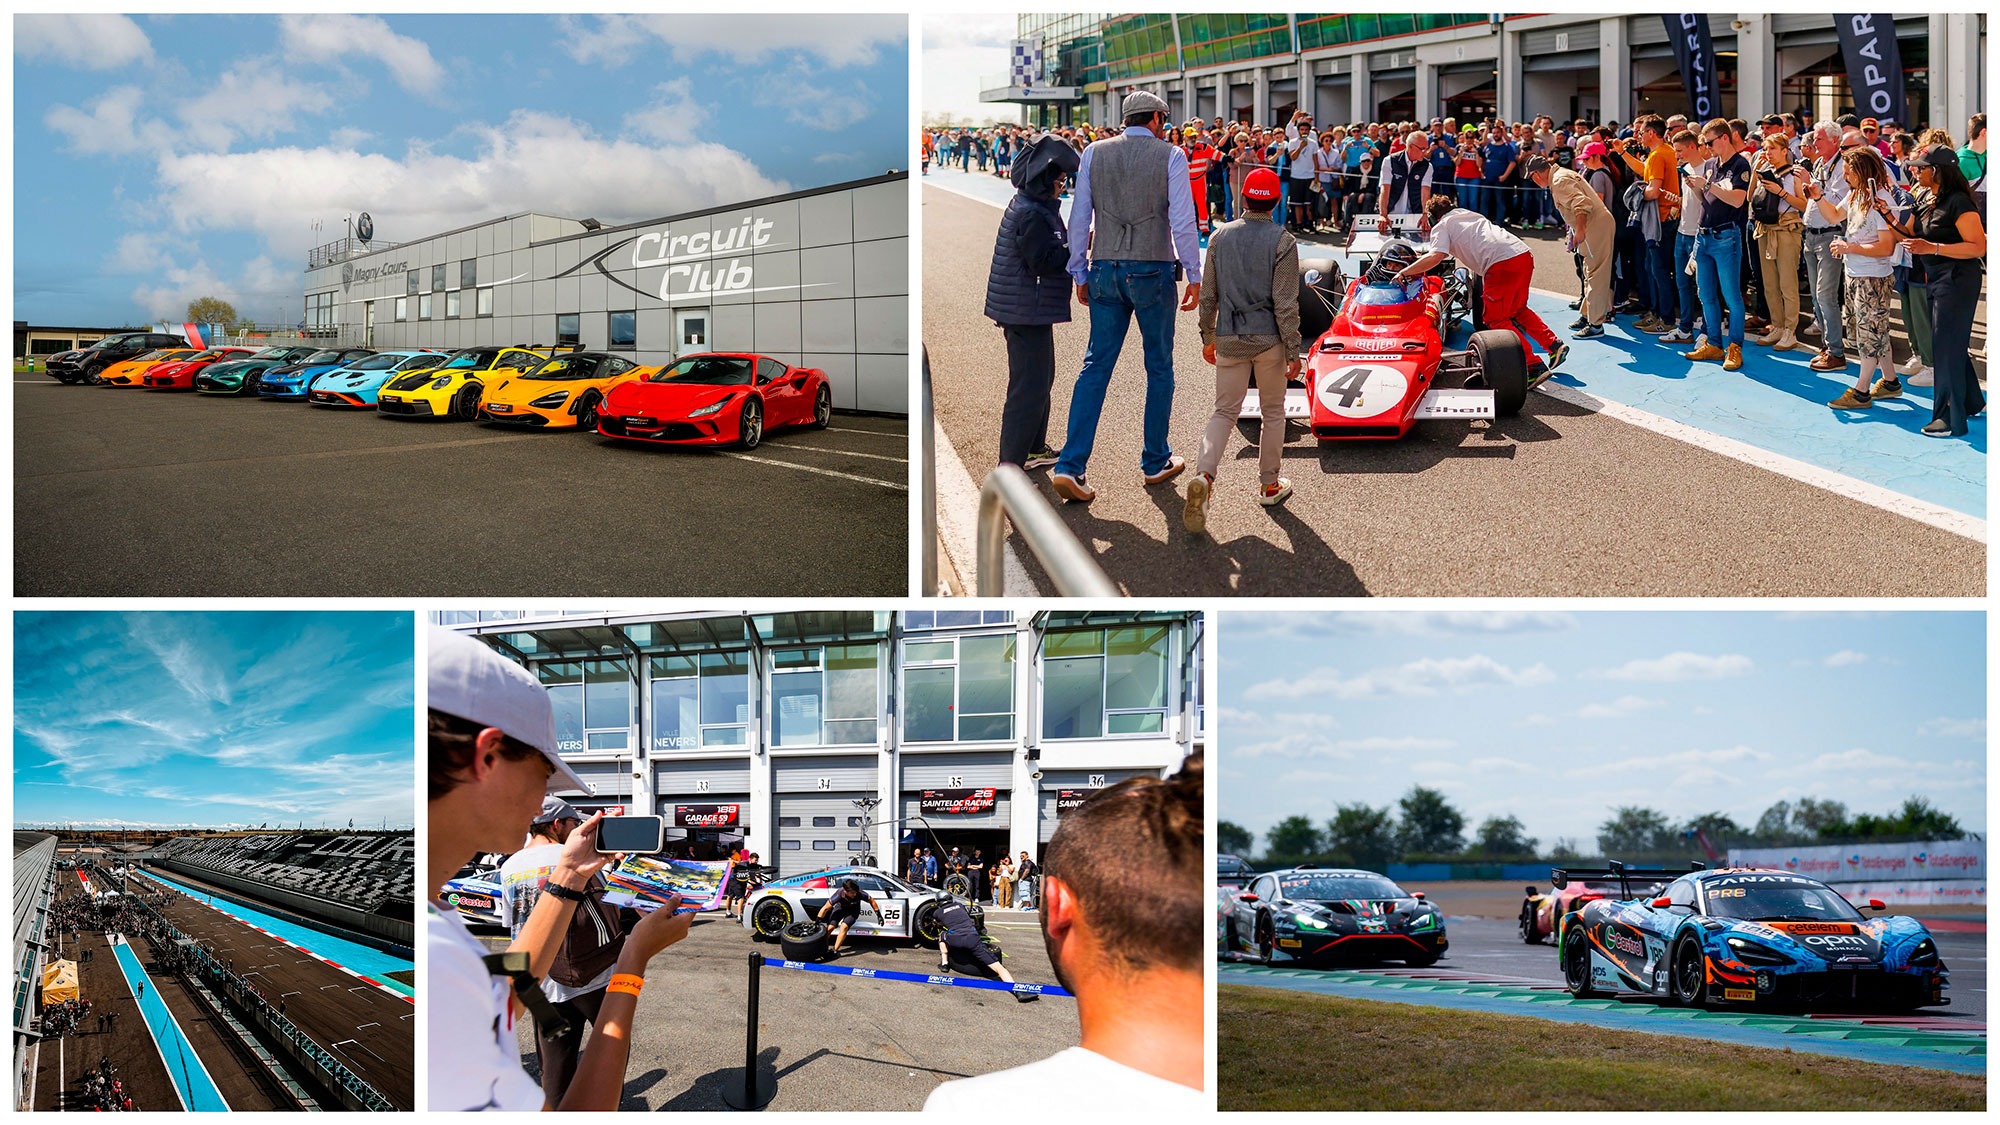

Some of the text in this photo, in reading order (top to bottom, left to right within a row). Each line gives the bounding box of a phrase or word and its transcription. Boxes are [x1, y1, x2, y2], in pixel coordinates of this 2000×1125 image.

[1557, 34, 1568, 50] 10
[1680, 13, 1710, 127] OPARD
[1852, 13, 1894, 126] OPAR
[632, 216, 774, 268] Circuit
[660, 259, 753, 302] Club
[1357, 338, 1396, 351] HEUER
[1325, 368, 1372, 408] 4
[557, 740, 583, 750] VERS
[654, 736, 697, 747] NEVERS
[698, 781, 709, 791] 33
[818, 779, 830, 789] 34
[949, 777, 962, 788] 35
[1090, 776, 1104, 787] 36
[1861, 856, 1906, 870] TotalEnergies
[1927, 854, 1977, 869] TotalEnergies
[1705, 876, 1826, 890] FANATEC
[460, 896, 491, 908] Castrol
[884, 909, 900, 919] 26
[1786, 923, 1841, 933] cetelem
[1615, 932, 1644, 957] Castrol
[1804, 935, 1868, 947] apm
[1592, 966, 1607, 976] MDS
[1726, 990, 1753, 999] PIRELLI
